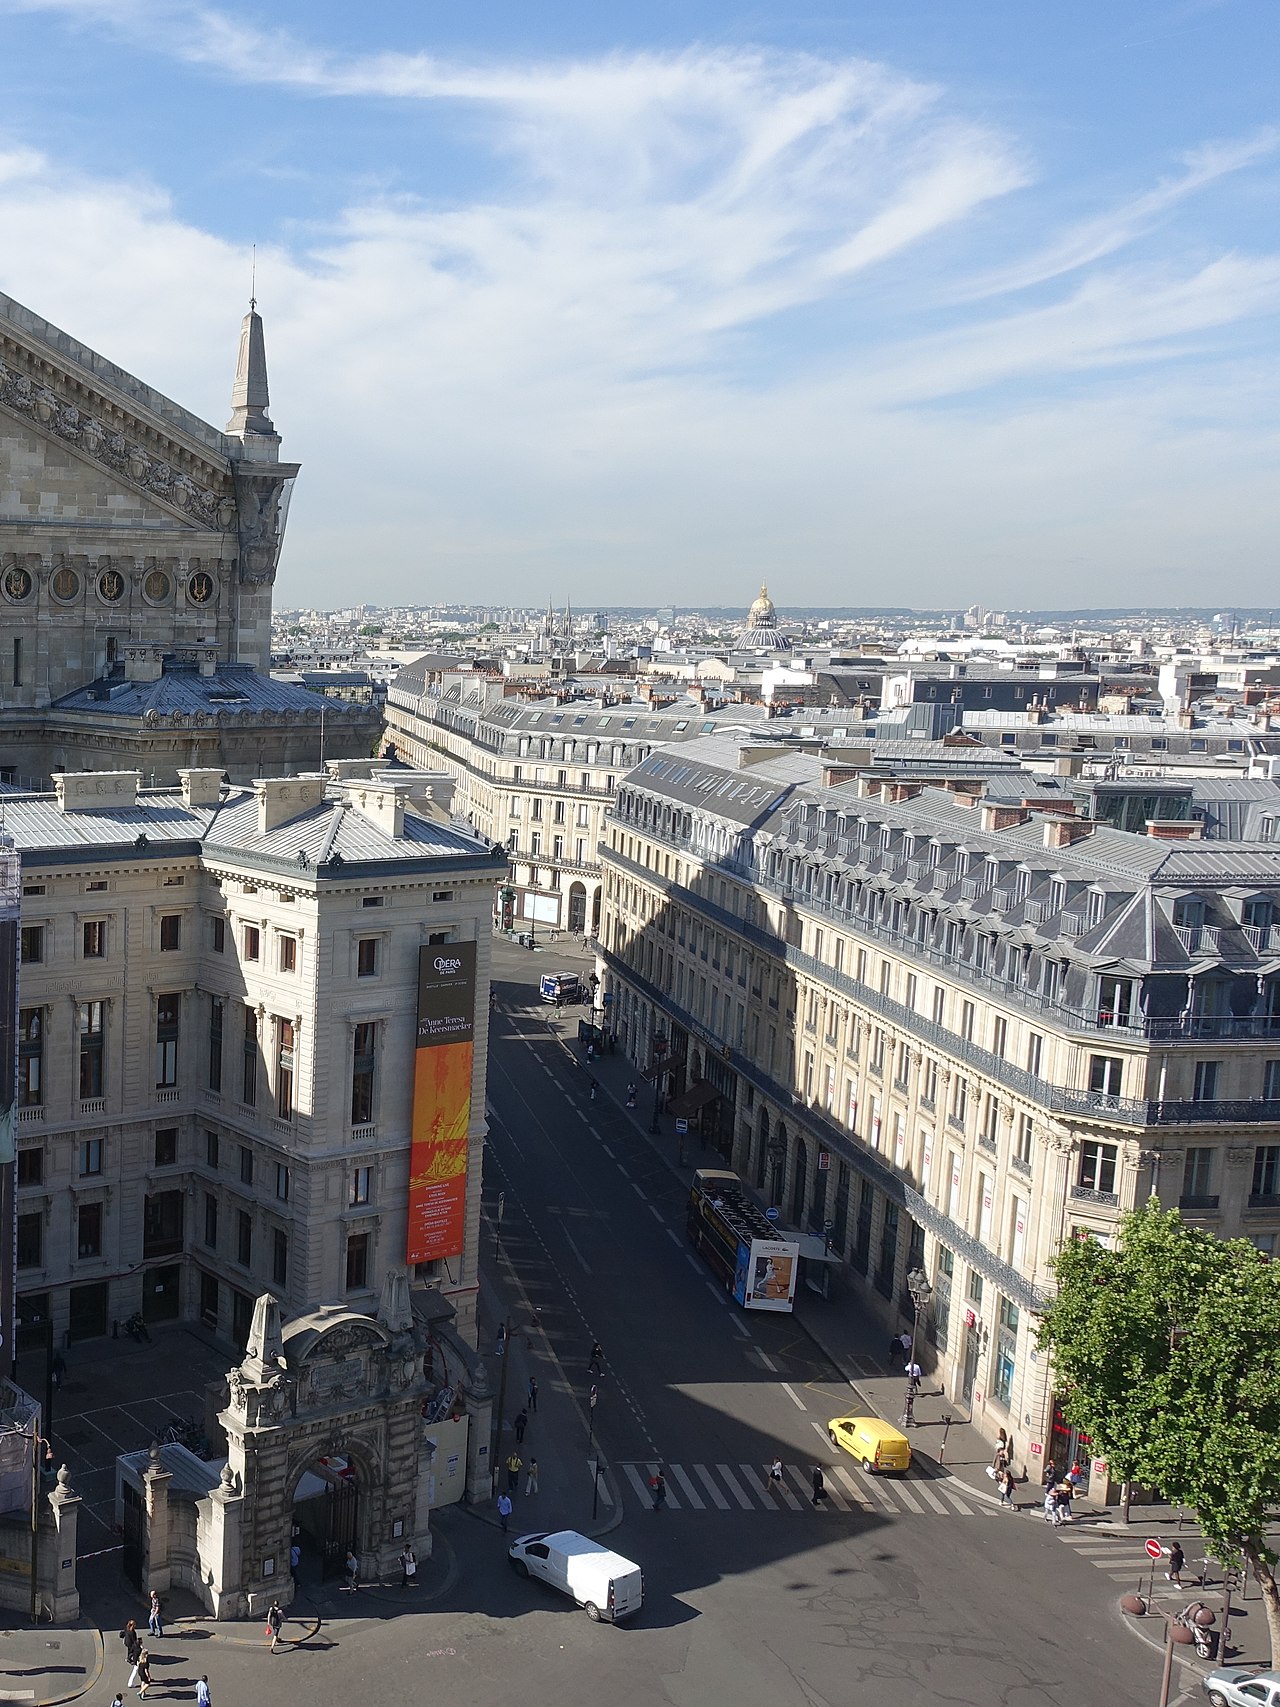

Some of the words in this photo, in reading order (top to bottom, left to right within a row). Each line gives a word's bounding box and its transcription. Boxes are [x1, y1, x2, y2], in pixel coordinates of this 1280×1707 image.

[425, 1019, 443, 1027] Anne
[444, 1016, 465, 1024] Teresa
[418, 1027, 428, 1035] De
[429, 1023, 472, 1034] Keersmaeker
